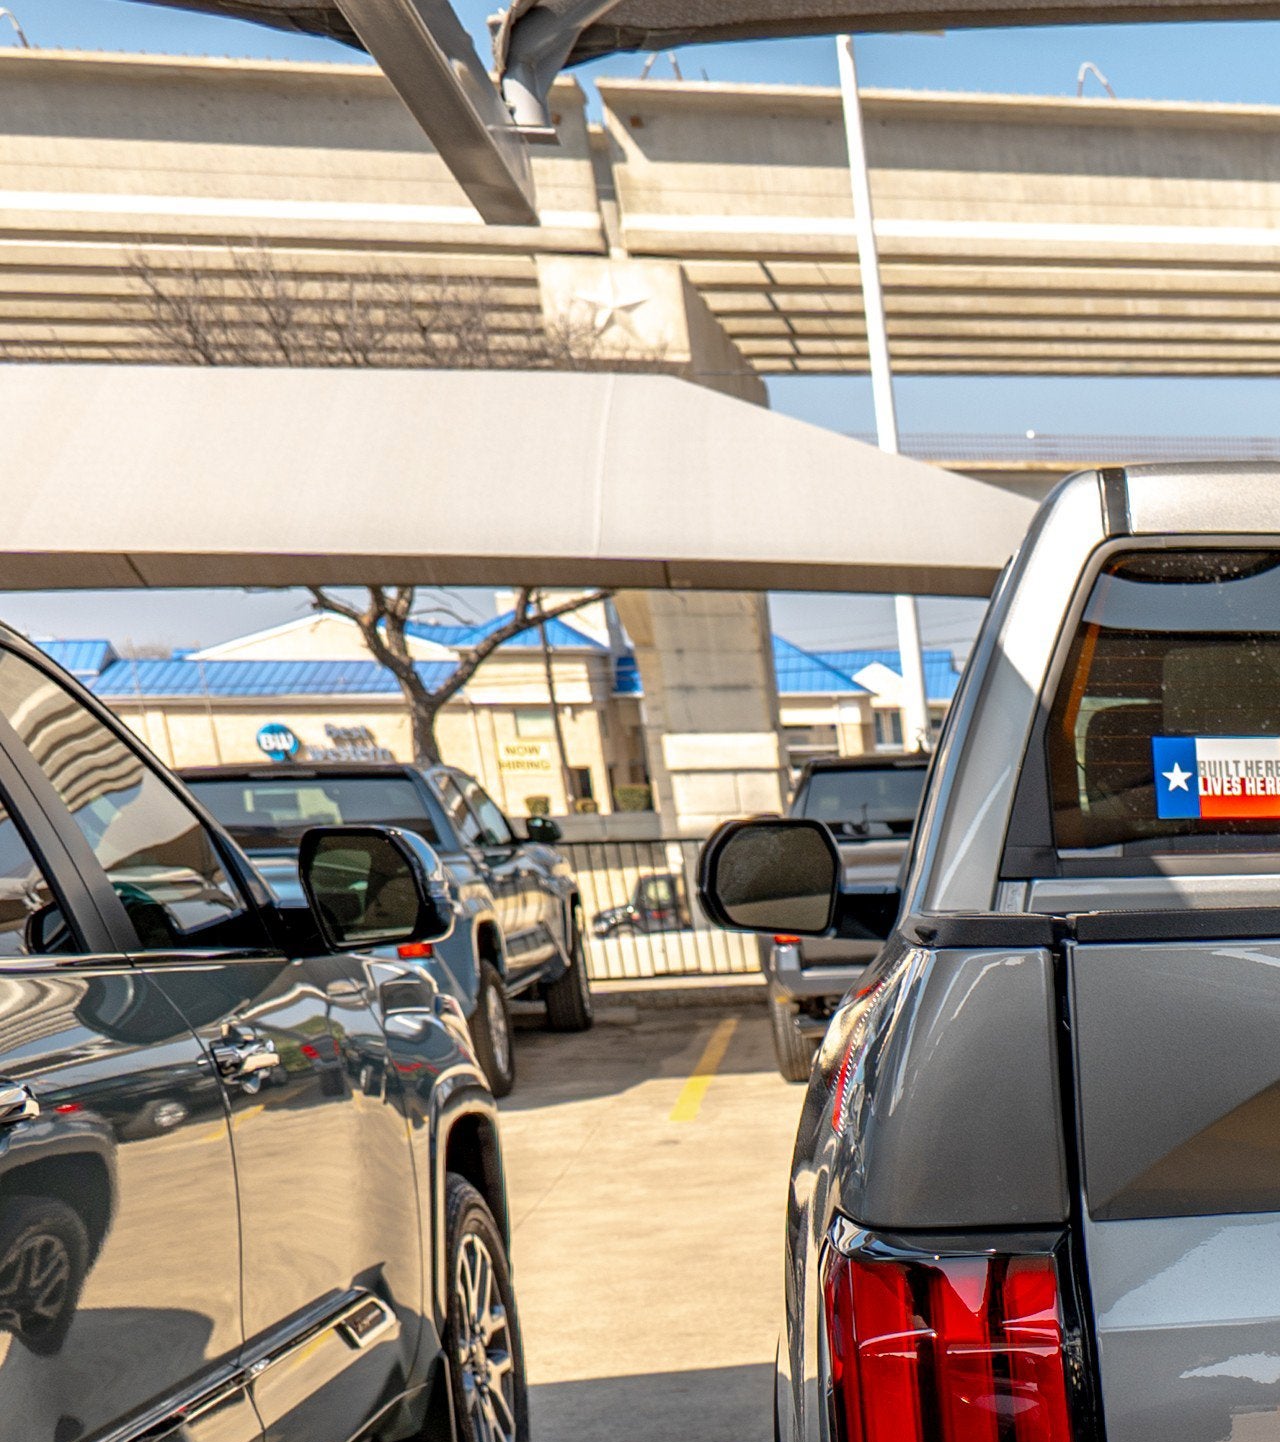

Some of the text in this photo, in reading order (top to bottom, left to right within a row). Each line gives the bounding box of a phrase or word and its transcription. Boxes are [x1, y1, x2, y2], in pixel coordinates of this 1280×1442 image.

[259, 732, 295, 750] BW
[1198, 760, 1240, 777] BUILT
[1199, 777, 1241, 796] LIVES
